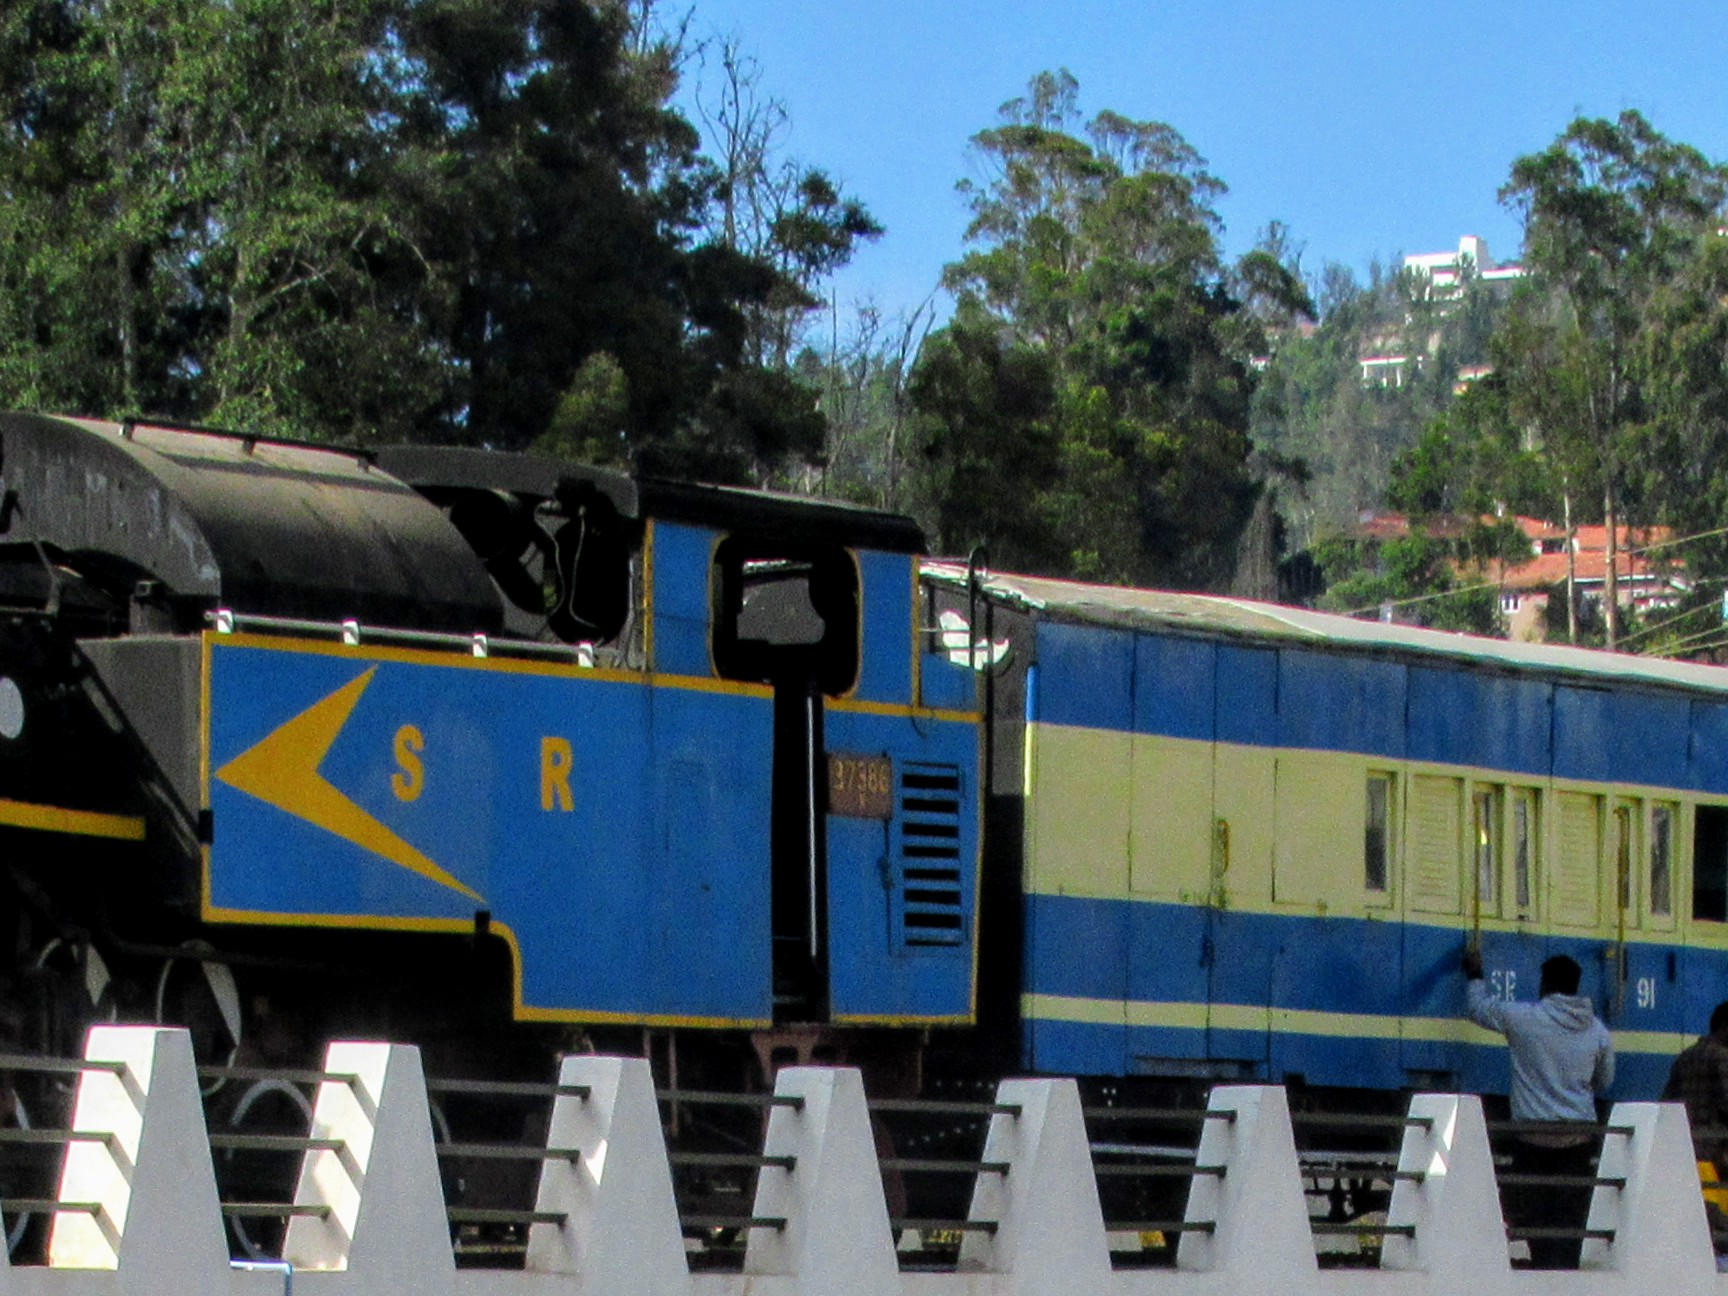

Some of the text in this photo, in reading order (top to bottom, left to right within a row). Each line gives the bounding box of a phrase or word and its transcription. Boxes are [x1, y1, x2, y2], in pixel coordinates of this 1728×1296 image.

[391, 724, 574, 812] S R
[1637, 978, 1655, 1009] 91
